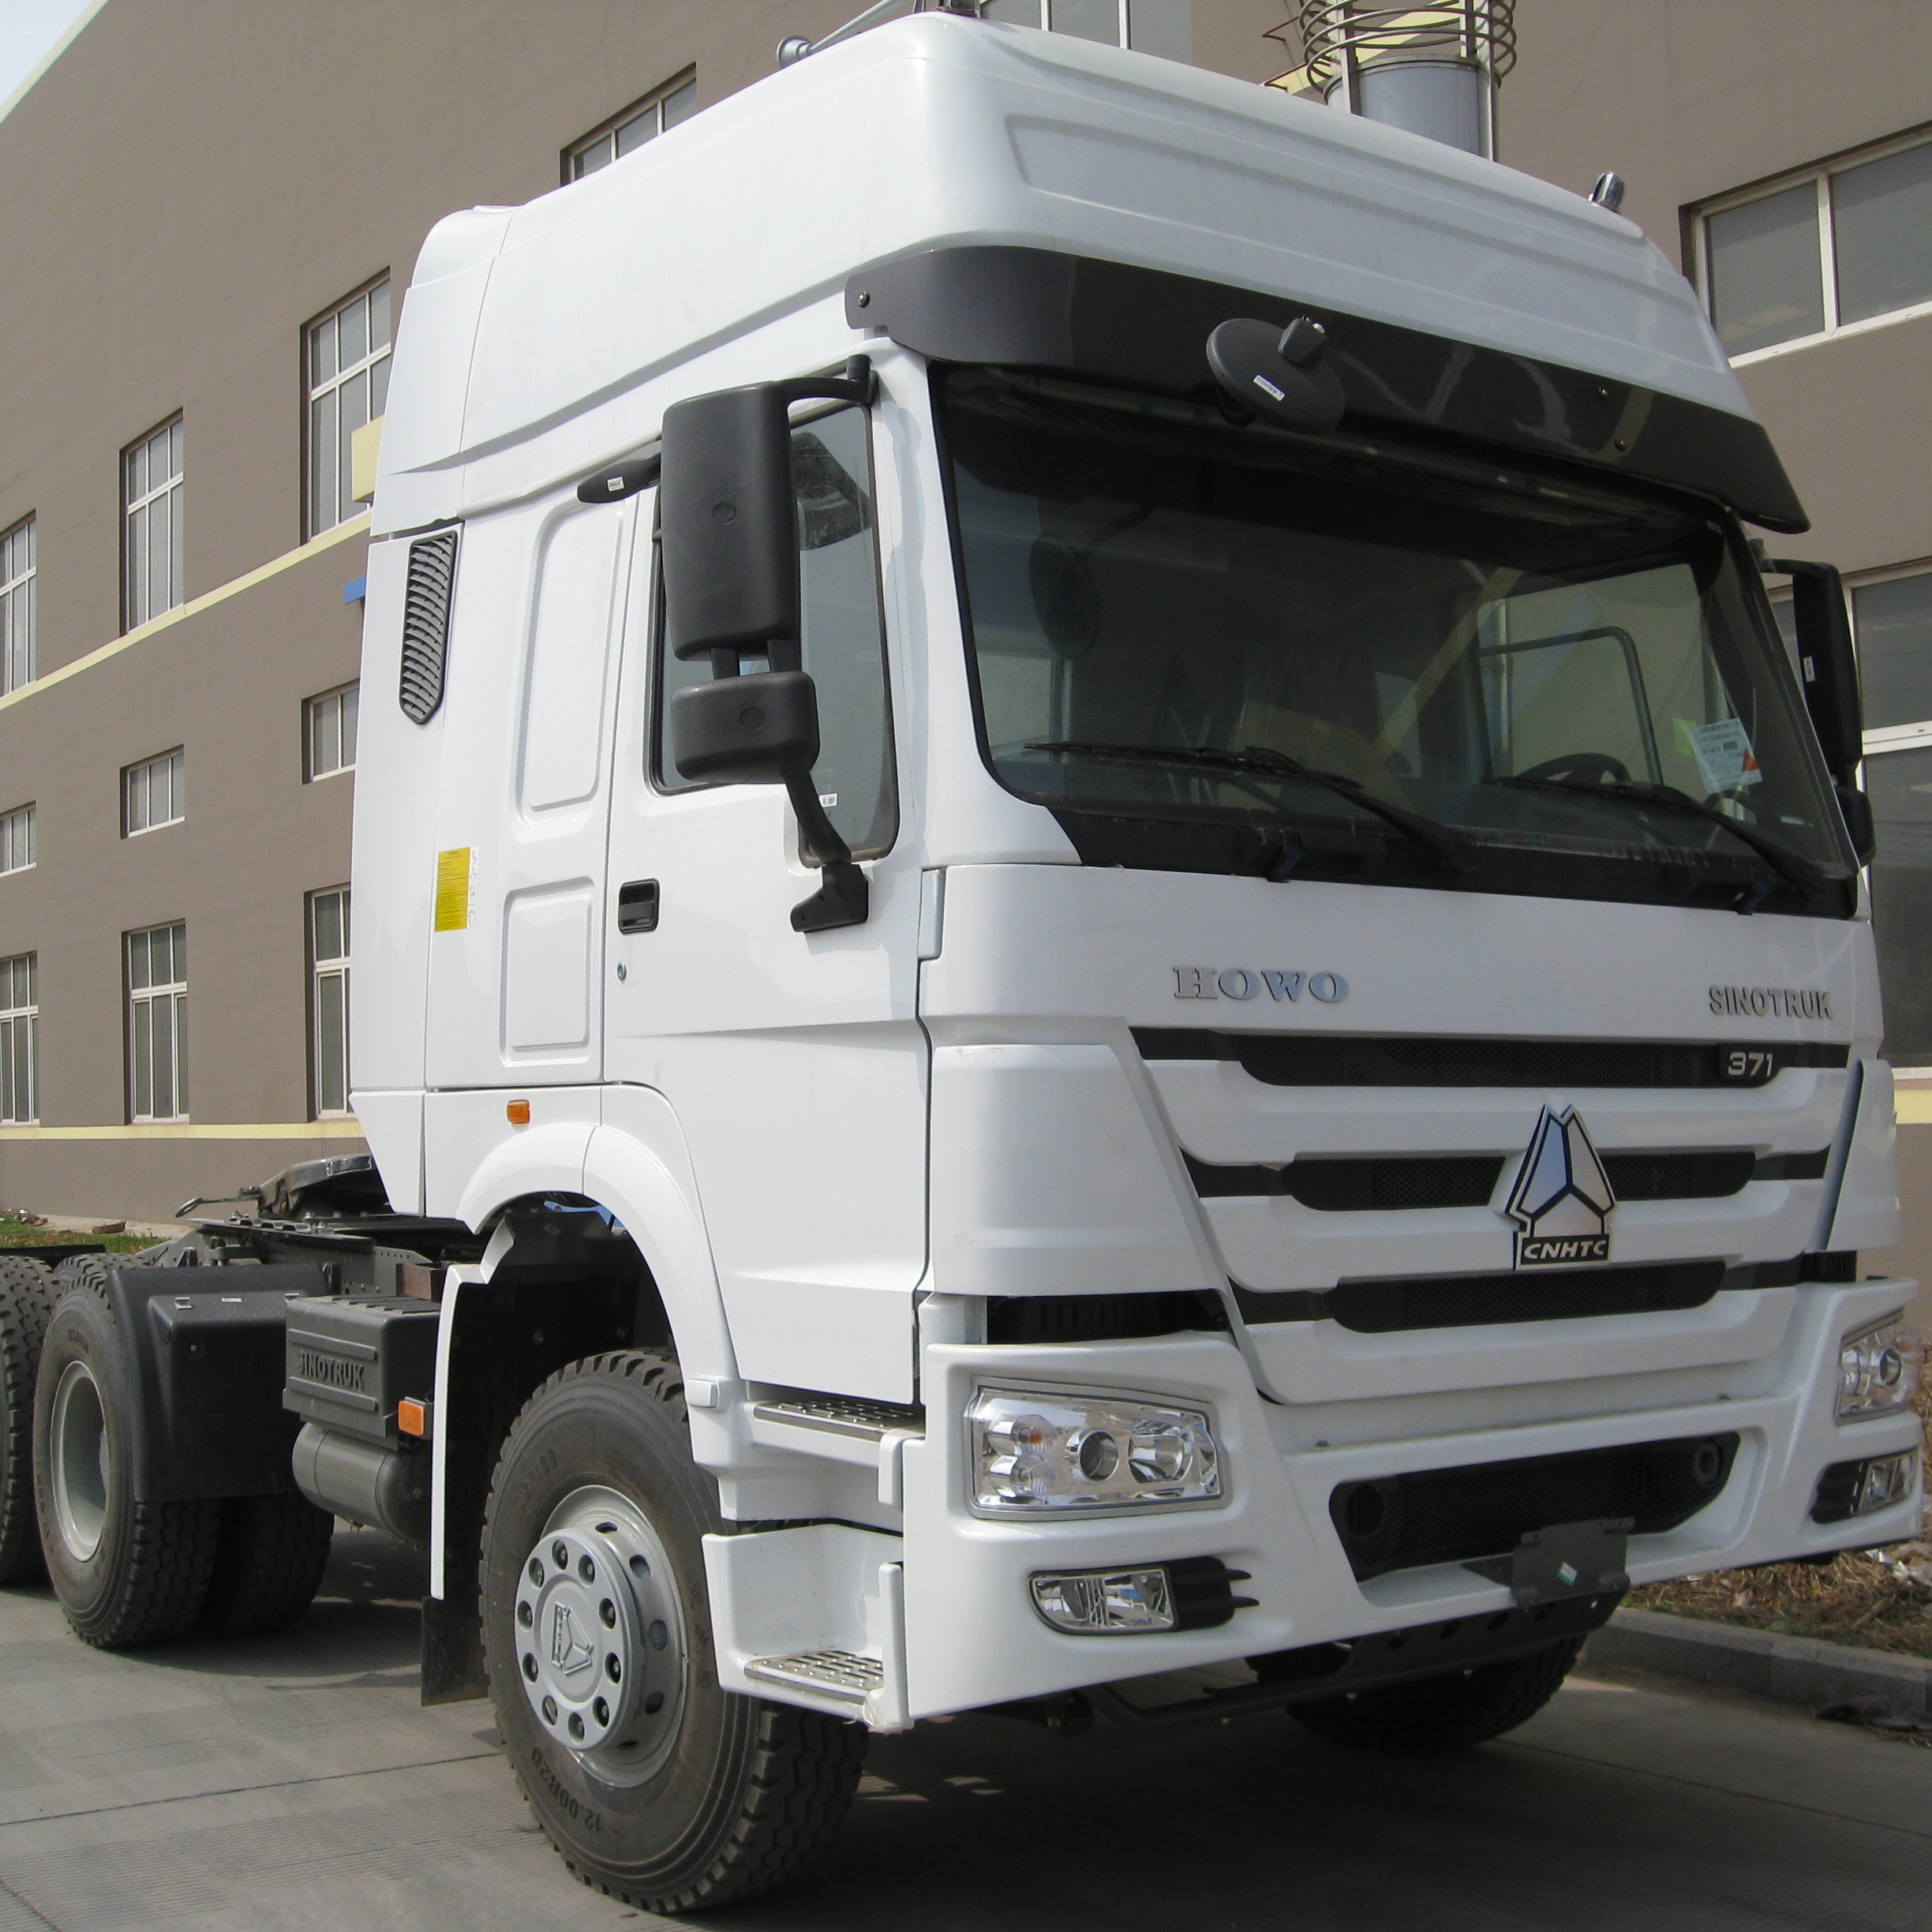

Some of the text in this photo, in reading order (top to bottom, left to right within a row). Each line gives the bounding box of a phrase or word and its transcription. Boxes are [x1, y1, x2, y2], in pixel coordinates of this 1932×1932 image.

[1173, 966, 1349, 1002] HOWO
[1709, 986, 1833, 1020] SINOTRUK
[1728, 1051, 1773, 1077] 371
[1524, 1240, 1607, 1260] CNHTC
